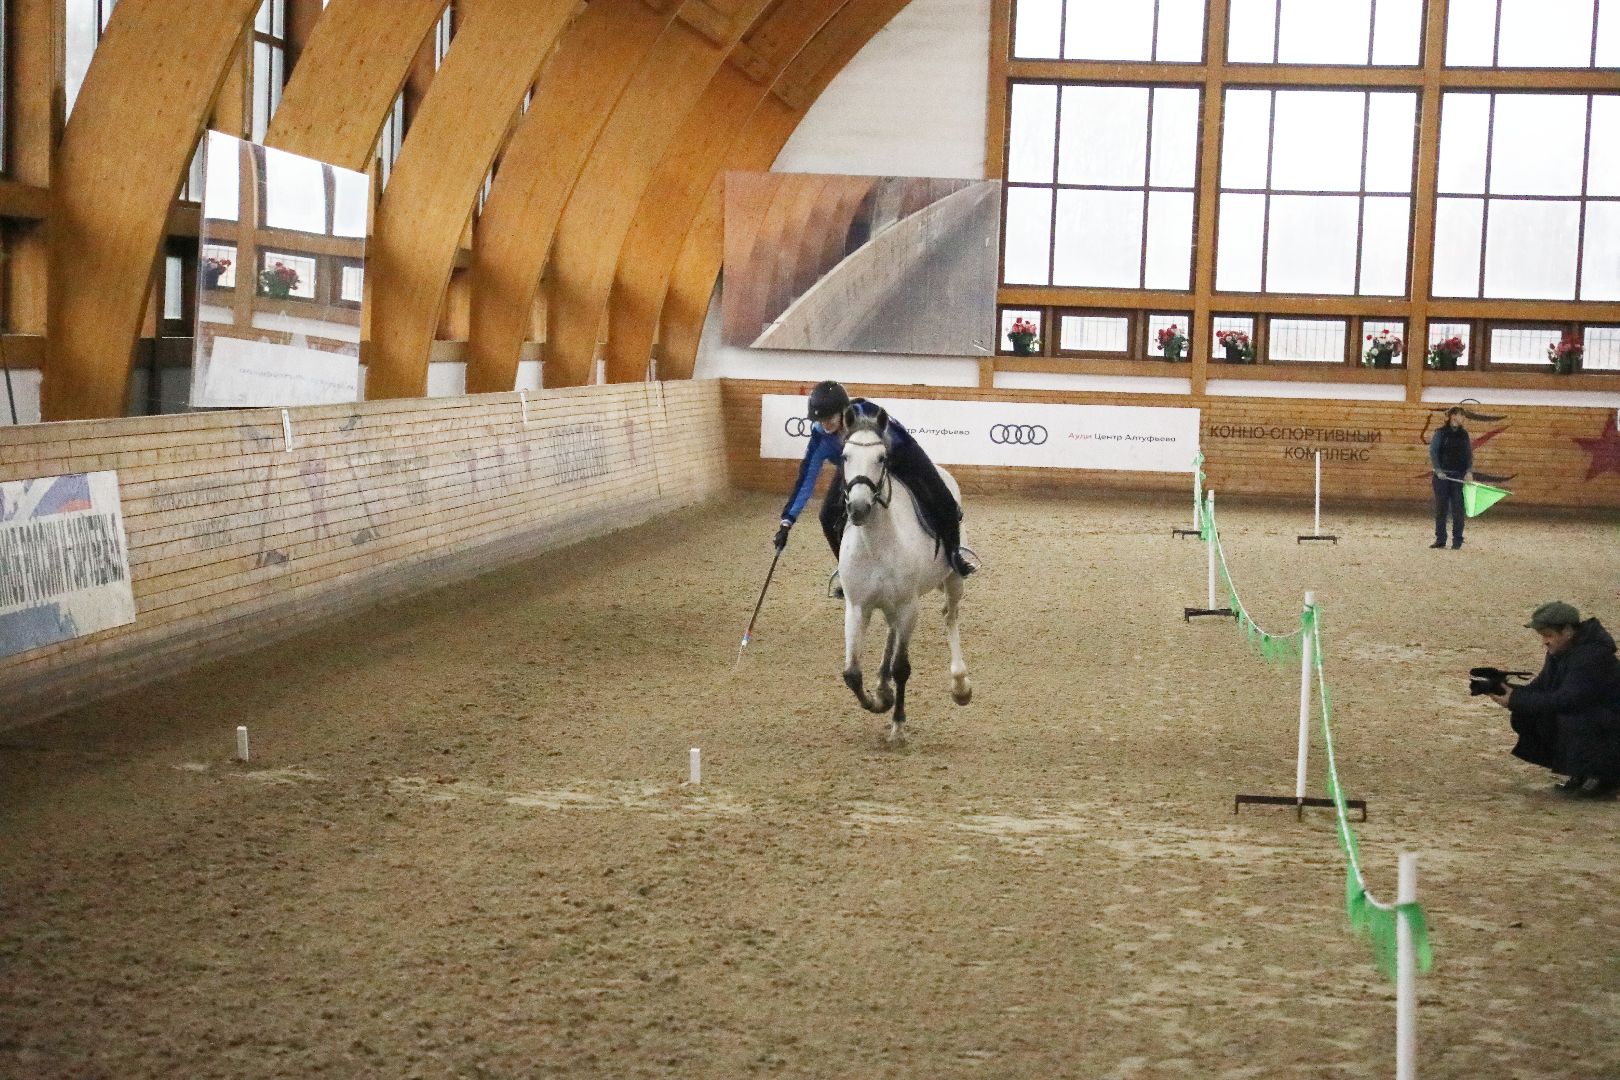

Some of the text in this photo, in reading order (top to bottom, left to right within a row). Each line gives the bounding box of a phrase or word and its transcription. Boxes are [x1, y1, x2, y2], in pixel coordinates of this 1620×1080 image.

[918, 427, 970, 436] Алтуфьево
[1209, 425, 1382, 443] КОННО-СПОРТИВНЫЙ
[1094, 433, 1123, 442] Центр
[1124, 434, 1176, 443] Алтуфьево
[1285, 447, 1370, 462] КОМПЛЕКС
